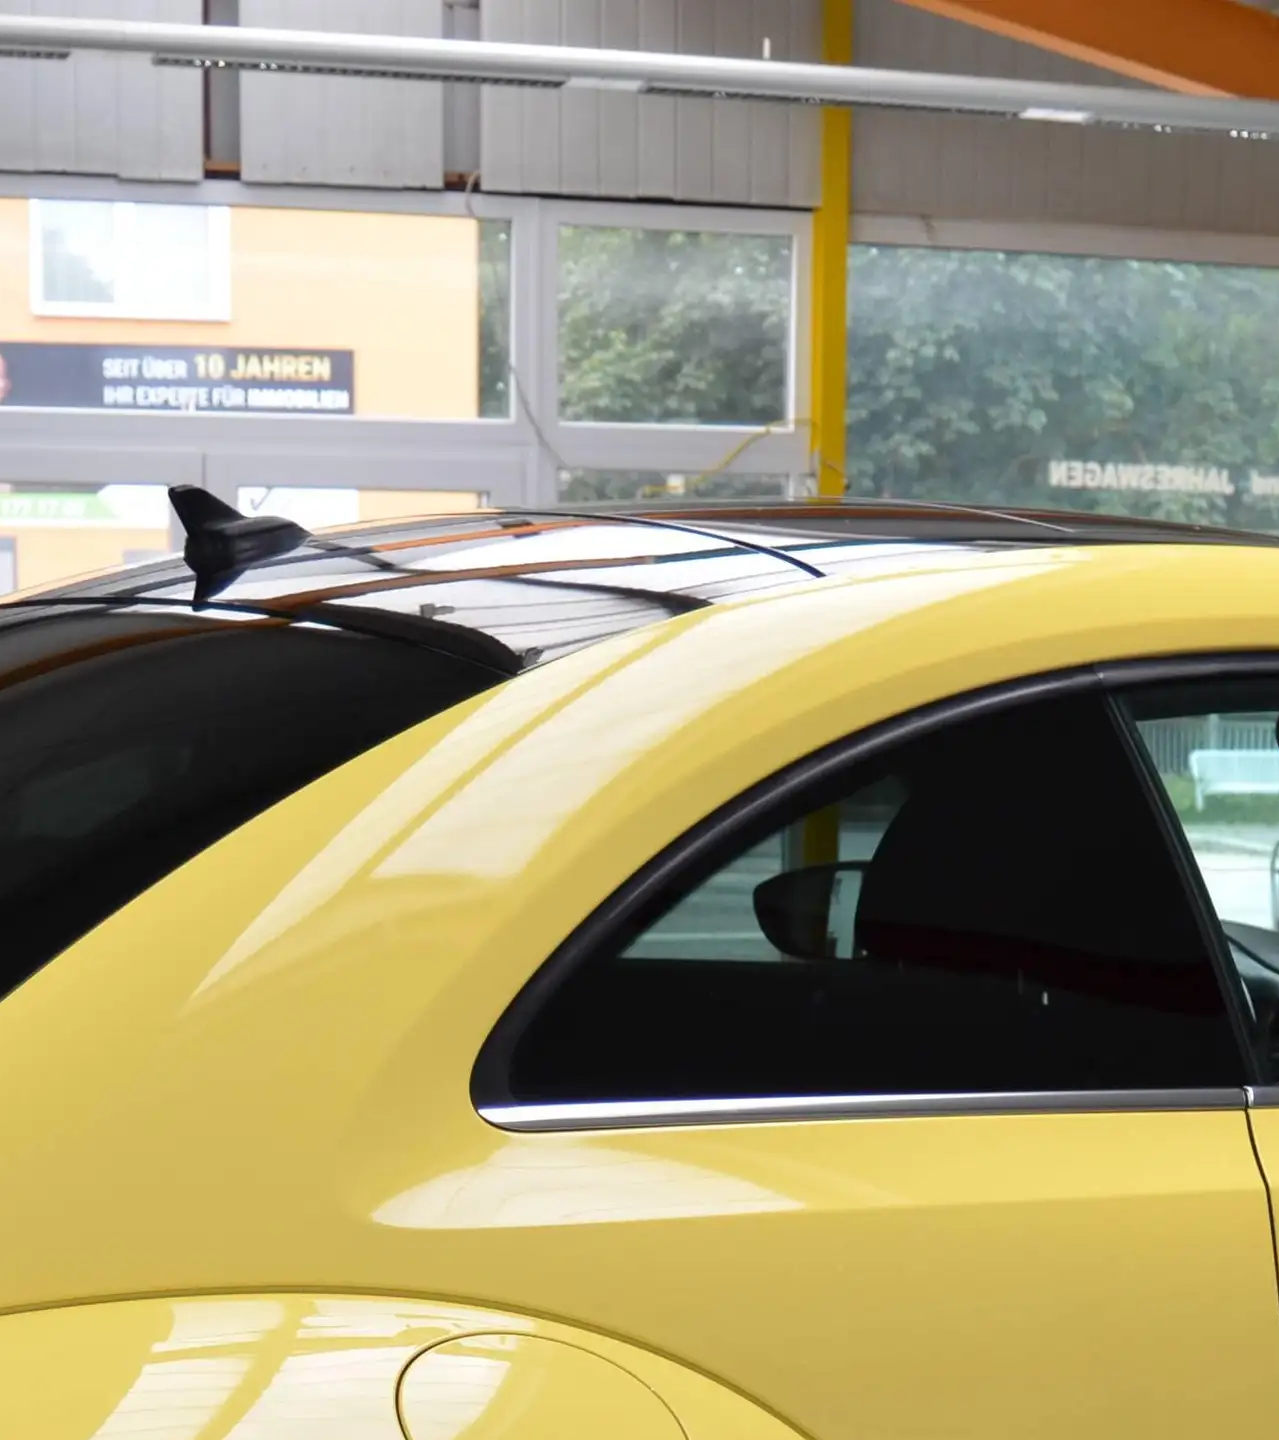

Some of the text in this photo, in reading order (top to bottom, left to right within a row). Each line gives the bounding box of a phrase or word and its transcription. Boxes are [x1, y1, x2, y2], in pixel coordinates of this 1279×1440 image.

[102, 357, 138, 379] SEIT
[230, 354, 331, 382] JAHREN
[212, 384, 246, 408] FÜR
